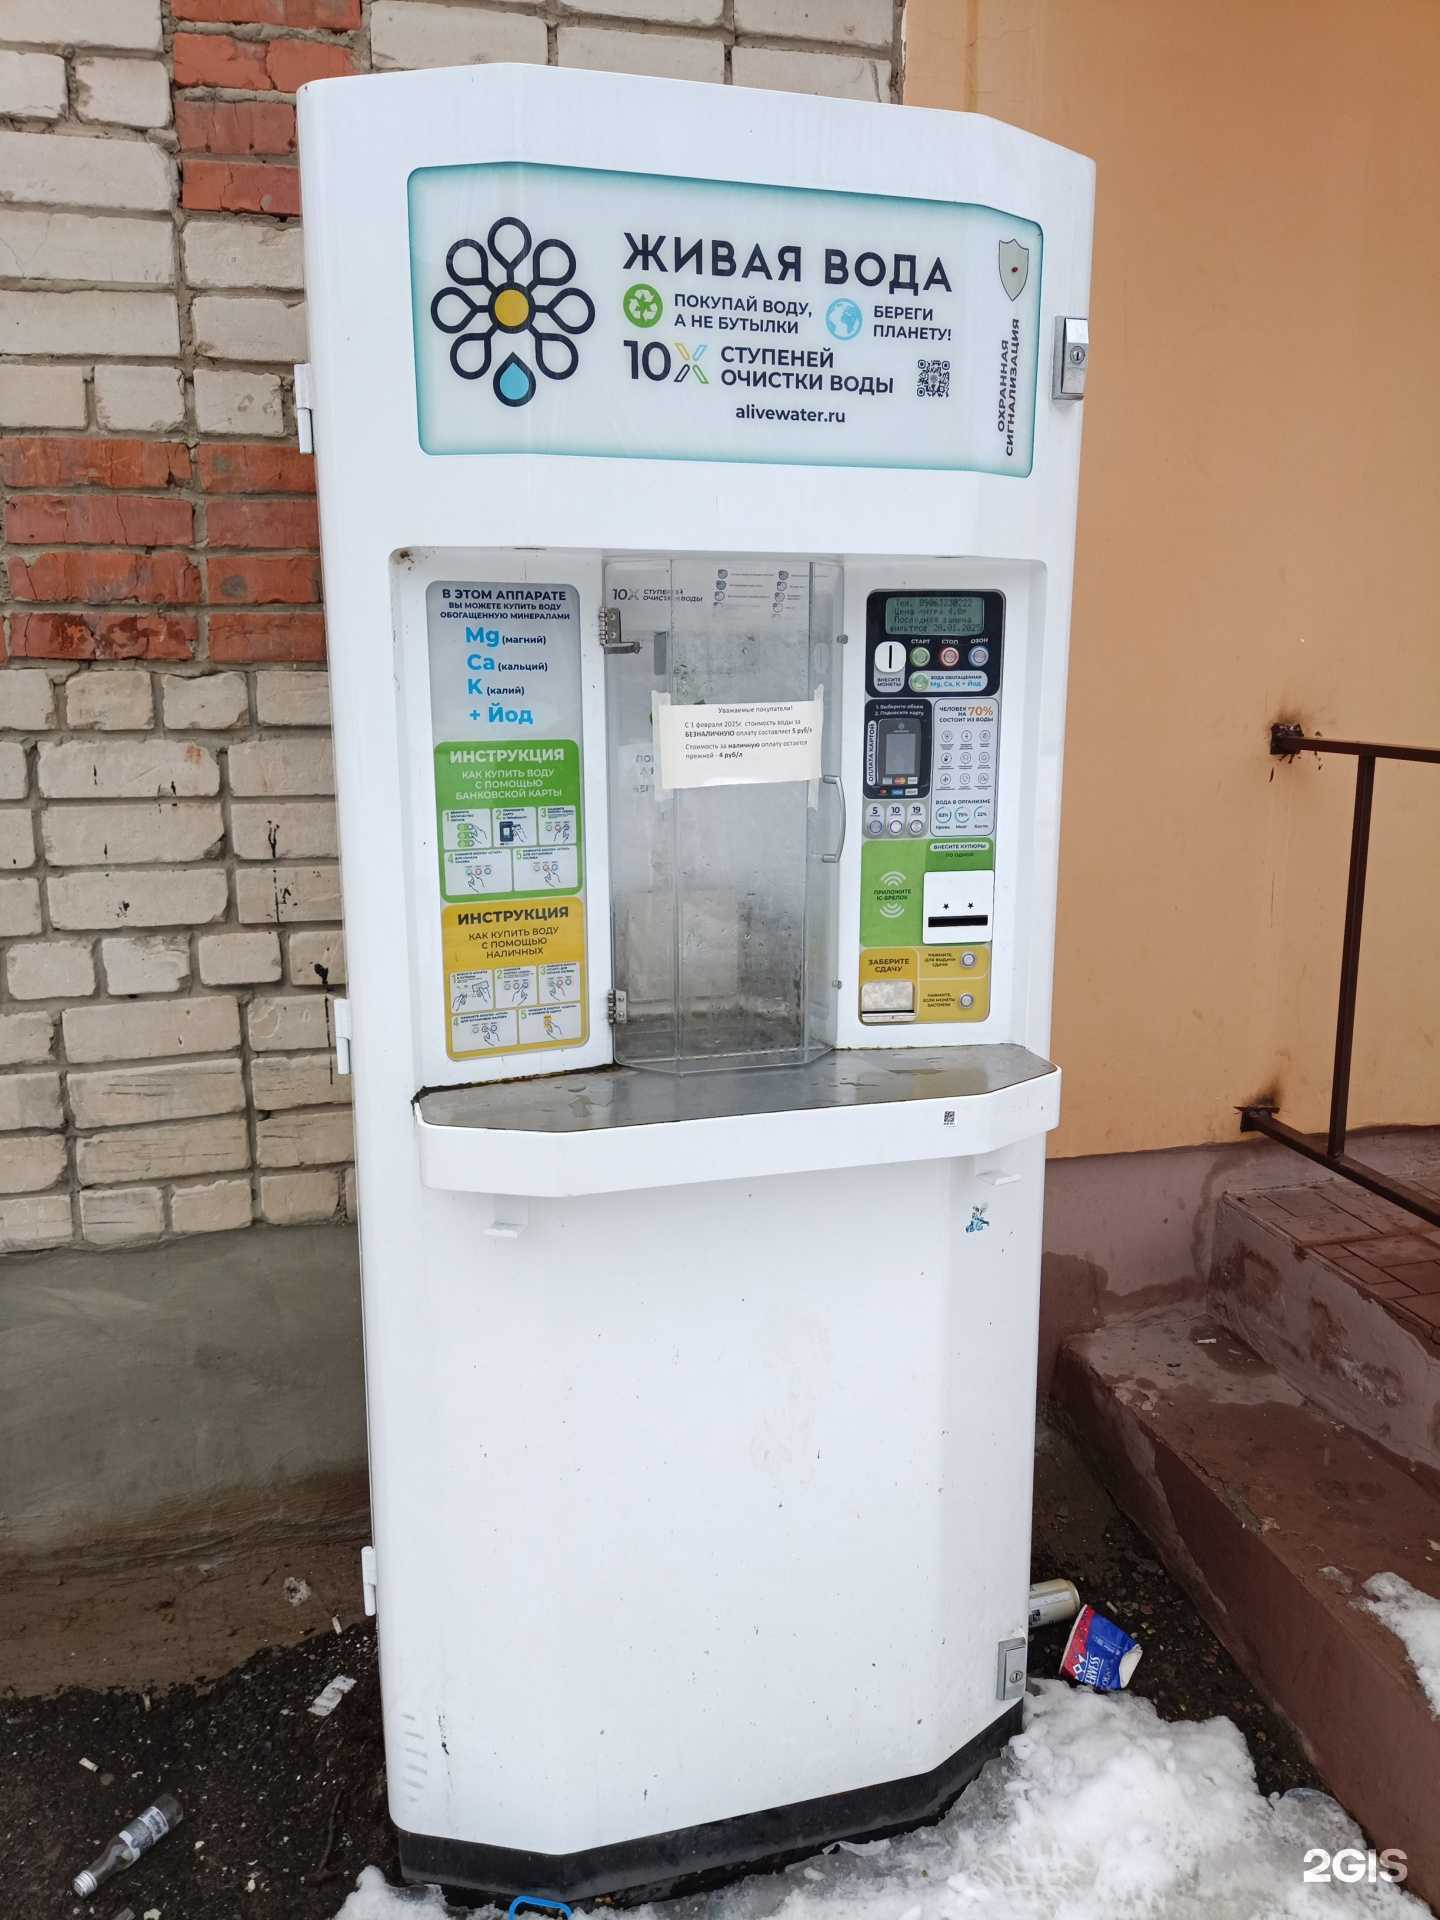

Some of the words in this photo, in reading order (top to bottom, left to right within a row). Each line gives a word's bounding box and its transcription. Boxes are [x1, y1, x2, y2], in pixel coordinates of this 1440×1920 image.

[622, 232, 802, 282] ЖИВАЯ
[824, 248, 953, 296] ВОДА
[674, 293, 758, 313] ПОКУПАЙ
[763, 300, 813, 319] ВОДУ,
[873, 305, 934, 321] БЕРЕГИ
[674, 315, 687, 328] А
[691, 315, 714, 329] НЕ
[718, 317, 799, 334] БУТЫЛКИ
[872, 324, 952, 341] ПЛАНЕТУ!
[720, 345, 834, 369] СТУПЕНЕЙ
[720, 369, 823, 391] ОЧИСТКИ
[830, 375, 894, 396] ВОДЫ
[997, 339, 1010, 434] ОХРАННАЯ
[1005, 318, 1020, 457] СИГНАЛИЗАЦИЯ
[735, 404, 846, 424] alivewater.ru
[442, 589, 451, 599] В
[455, 589, 492, 599] ЭТОМ
[496, 590, 567, 601] АППАРАТЕ
[465, 602, 501, 610] МОЖЕТЕ
[539, 603, 562, 611] ВОДУ
[440, 612, 509, 620] ОБОГАЩЕННУЮ
[510, 612, 570, 620] МИНЕРАЛАМИ
[465, 626, 500, 648] Mg
[502, 635, 547, 645] (магний)
[498, 662, 548, 672] (кальций)
[486, 686, 525, 696] (калий)
[488, 702, 534, 725] Йод
[968, 706, 993, 716] 70%
[685, 730, 735, 738] БЕЗНАЛИЧНУЮ
[728, 742, 760, 750] наличную
[450, 748, 565, 764] ИНСТРУКЦИЯ
[462, 771, 481, 780] КАК
[484, 769, 525, 779] КУПИТЬ
[527, 768, 554, 778] ВОДУ
[475, 781, 482, 789] С
[484, 779, 544, 789] ПОМОЩЬЮ
[456, 790, 527, 800] БАНКОВСКОЙ
[528, 789, 562, 798] КАРТЫ
[872, 807, 879, 815] 5
[891, 806, 900, 814] 10
[912, 806, 921, 814] 19
[458, 906, 569, 925] ИНСТРУКЦИЯ
[468, 932, 489, 941] КАК
[491, 929, 530, 939] КУПИТЬ
[532, 926, 559, 937] ВОДУ
[482, 941, 488, 950] С
[491, 937, 548, 950] ПОМОЩЬЮ
[486, 947, 544, 959] НАЛИЧНЫХ
[868, 958, 910, 966] ЗАБЕРИТЕ
